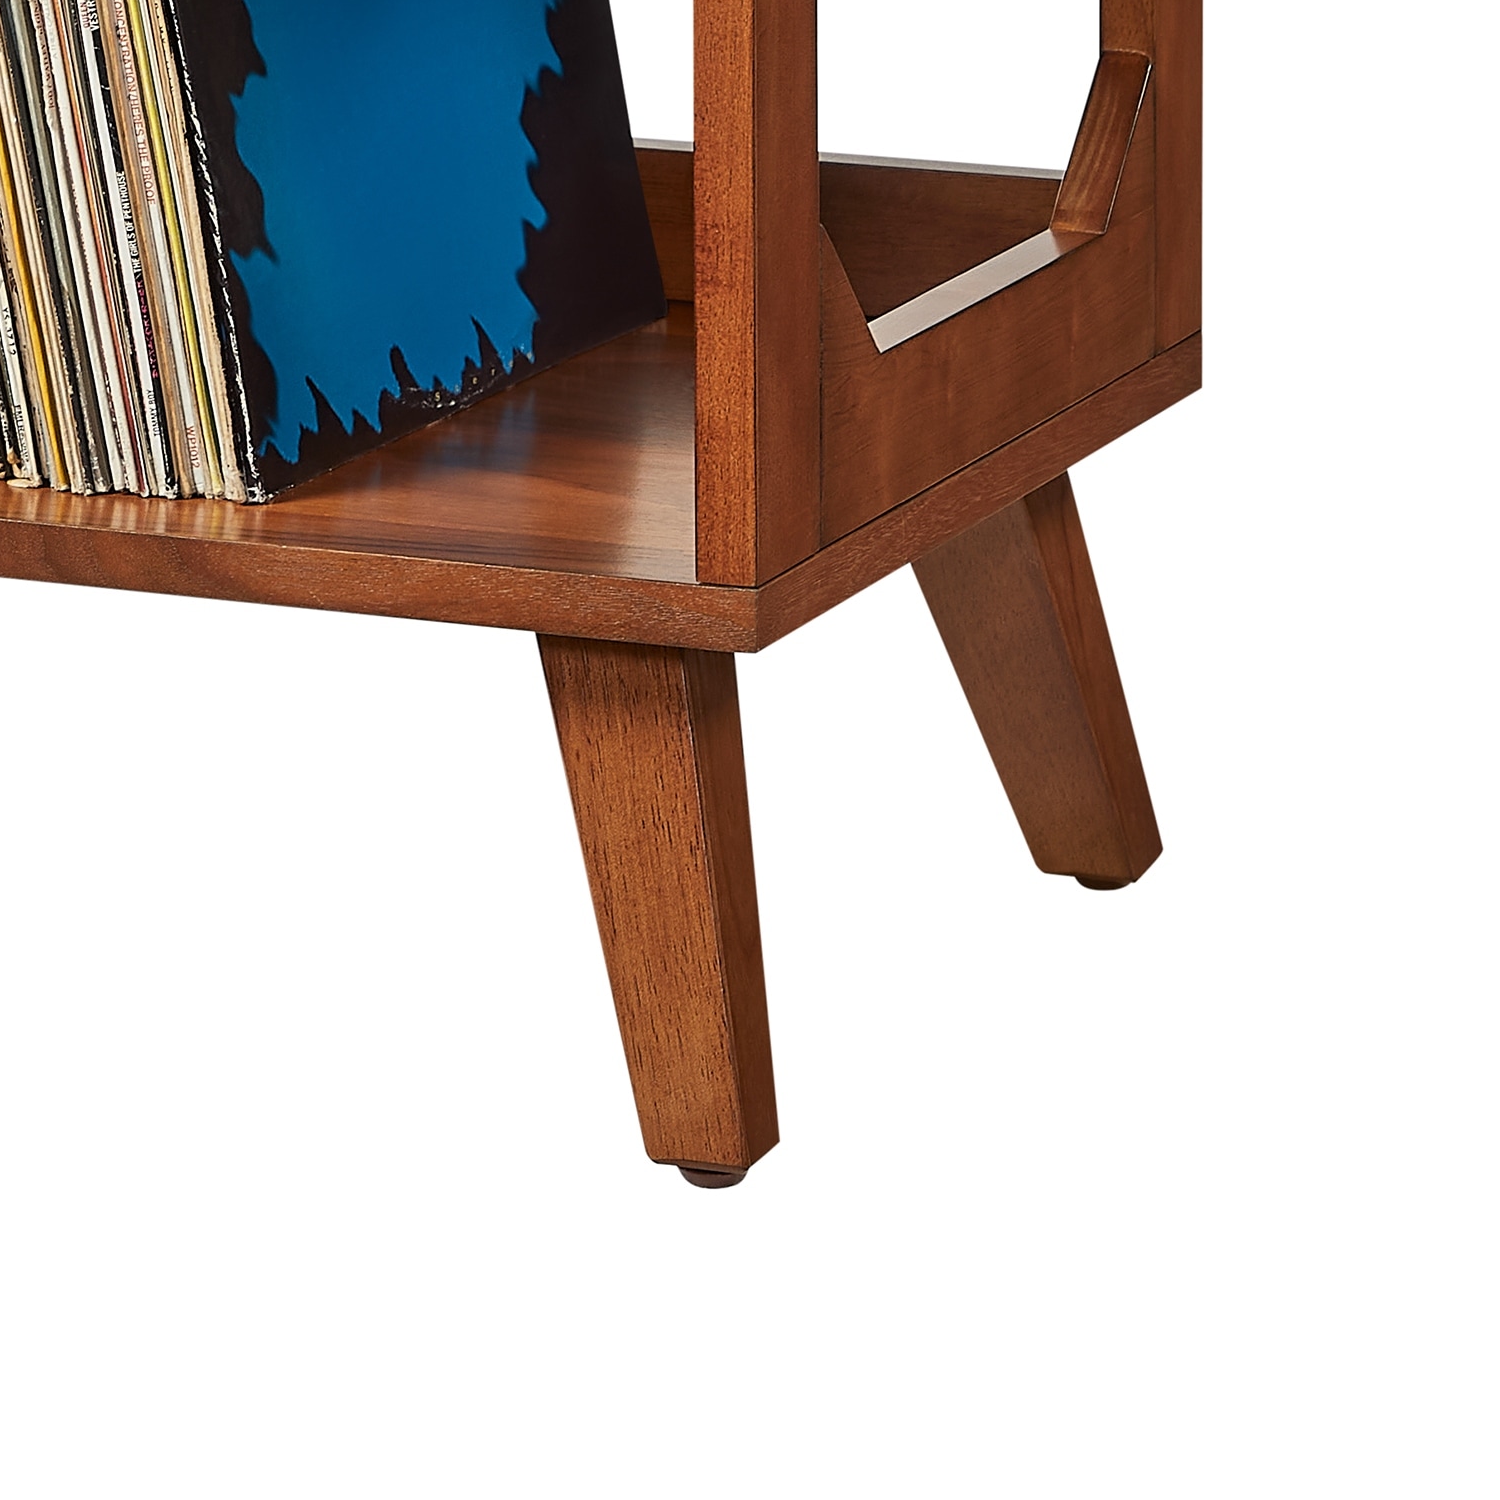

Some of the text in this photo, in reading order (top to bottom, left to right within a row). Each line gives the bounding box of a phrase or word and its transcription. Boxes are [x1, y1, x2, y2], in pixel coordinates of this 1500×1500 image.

[77, 0, 90, 29] QUEEN
[136, 140, 149, 162] THE
[141, 164, 156, 205] PROOF
[116, 169, 142, 273] THE GIRLS OF PENTHOUSE
[185, 425, 200, 469] WP1012
